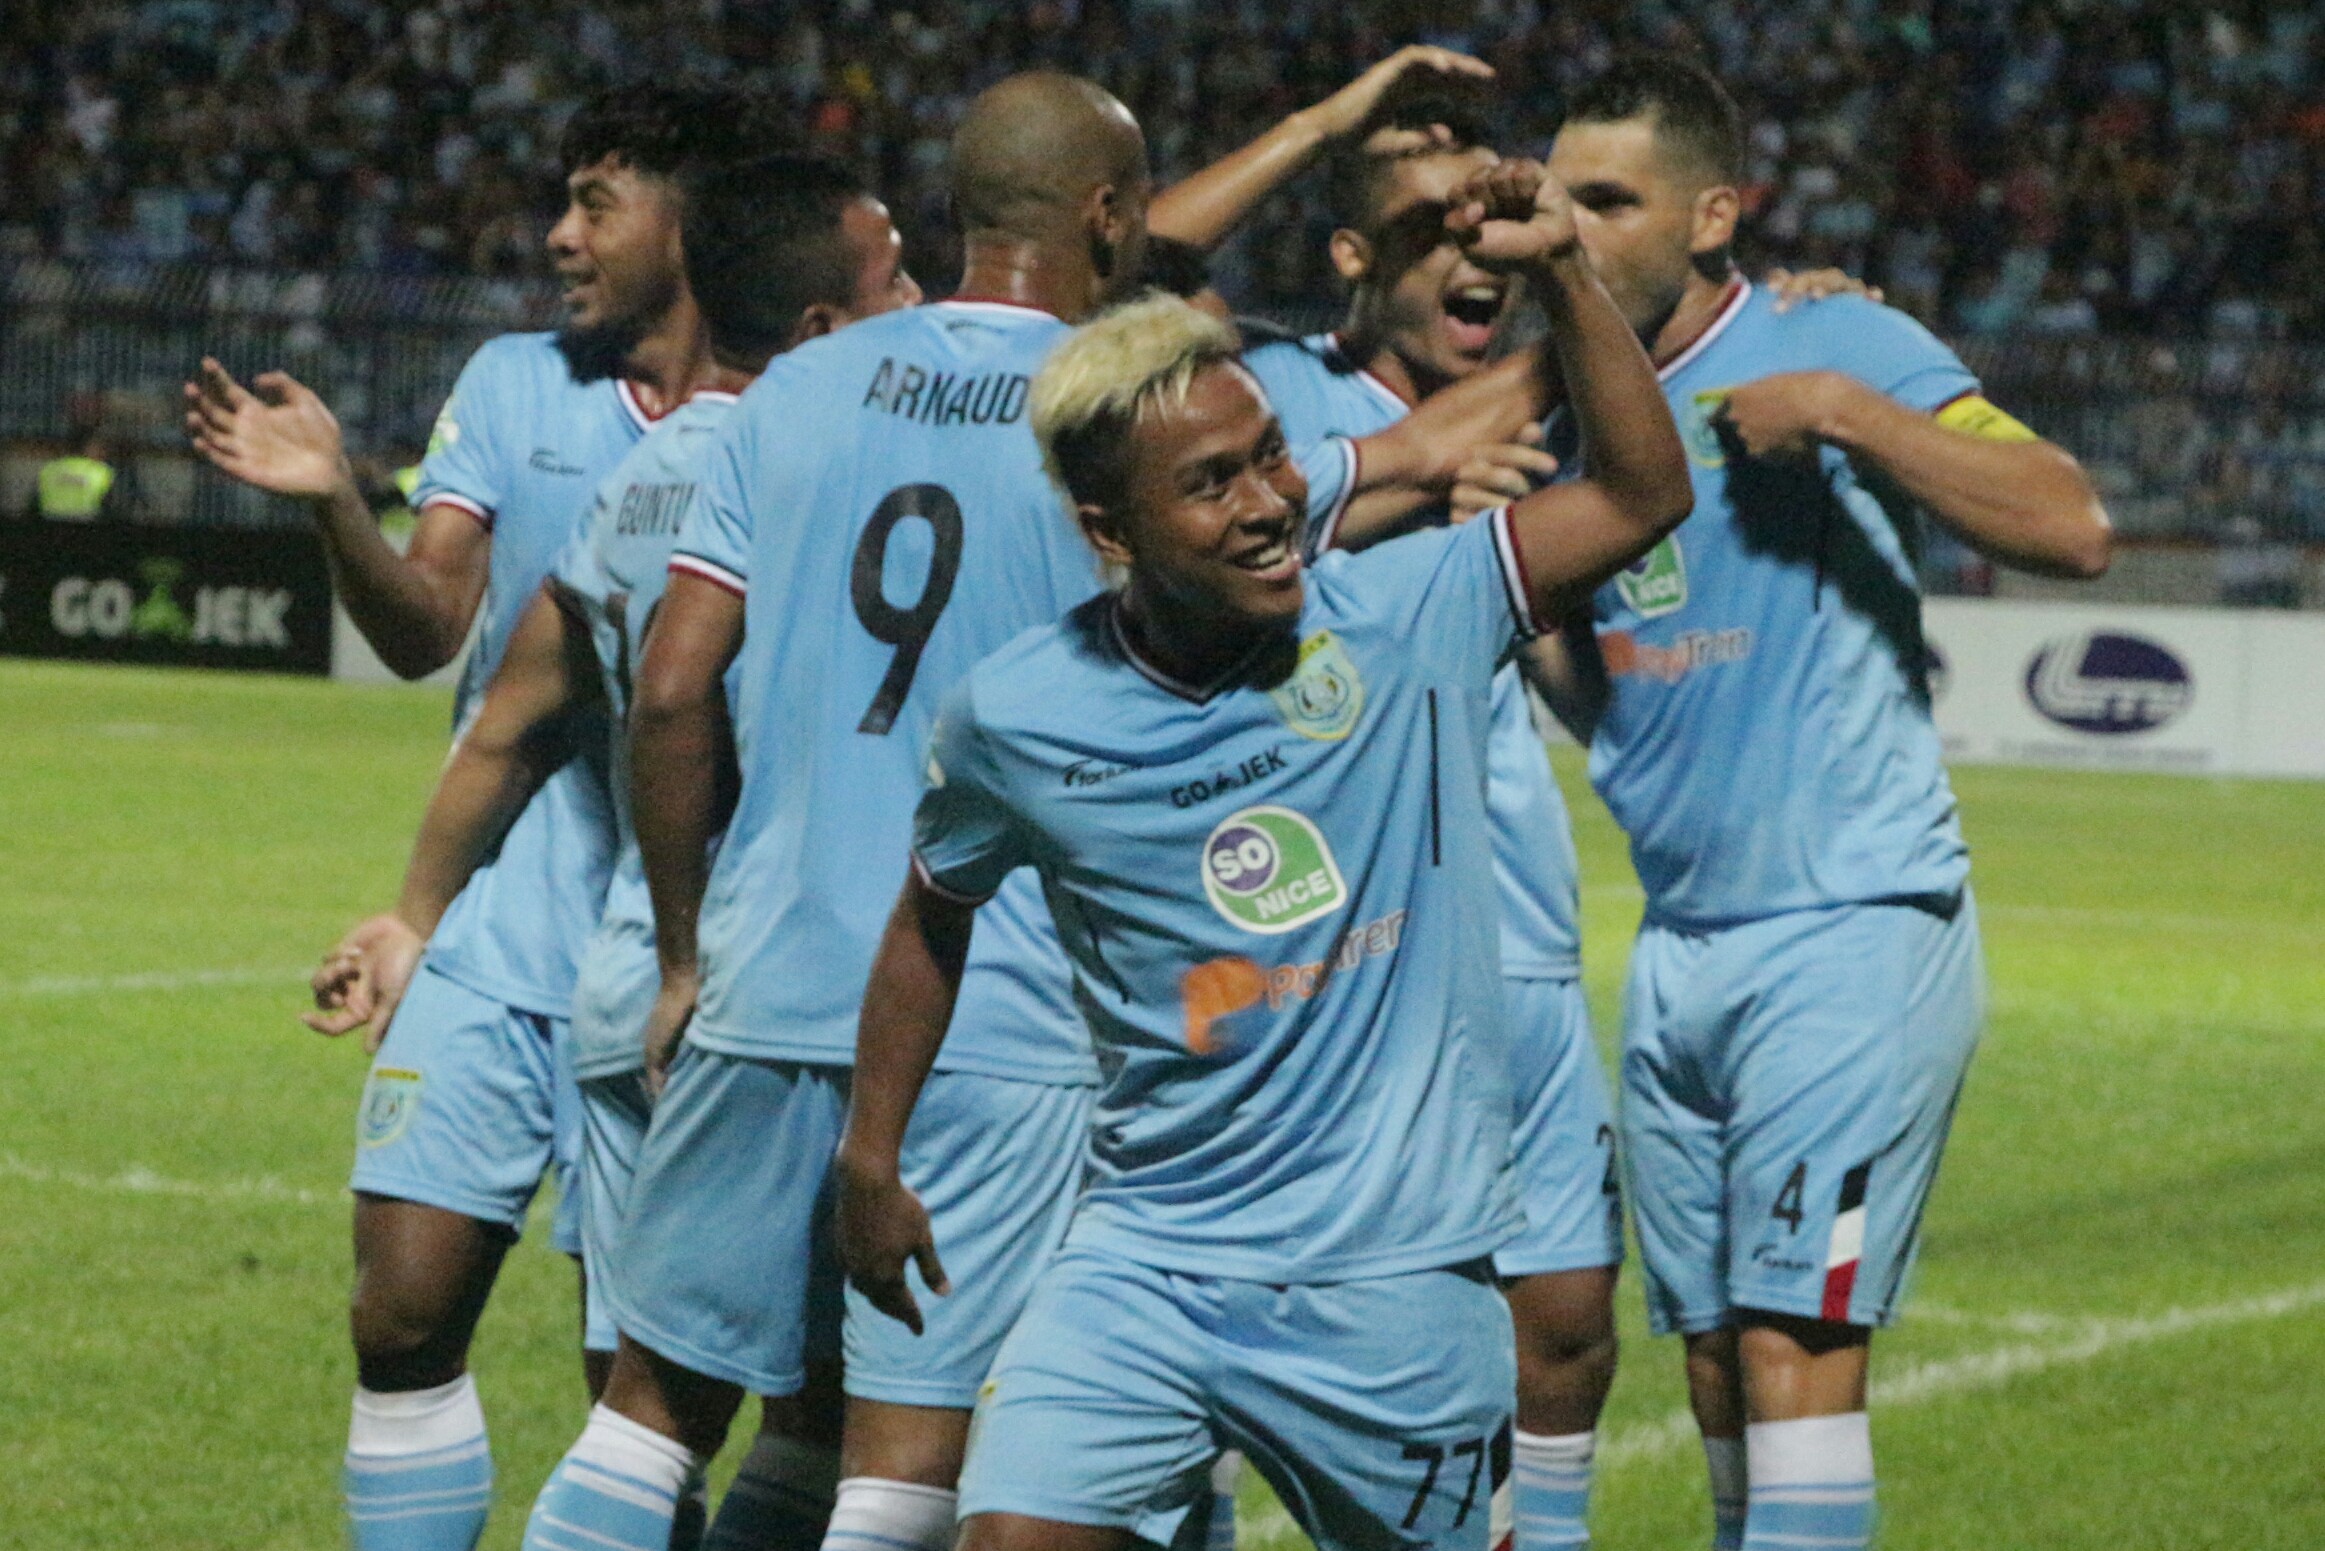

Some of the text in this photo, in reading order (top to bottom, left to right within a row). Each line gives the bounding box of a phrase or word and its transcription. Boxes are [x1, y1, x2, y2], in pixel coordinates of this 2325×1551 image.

[862, 356, 1031, 428] ARNAUD
[51, 576, 132, 638] GO
[194, 585, 294, 647] JEK
[850, 482, 964, 736] 9
[1170, 746, 1289, 809] GO JEK
[1212, 837, 1271, 881] SO
[1254, 867, 1333, 920] NICE
[1771, 1160, 1807, 1236] 4
[1401, 1436, 1485, 1532] 77
